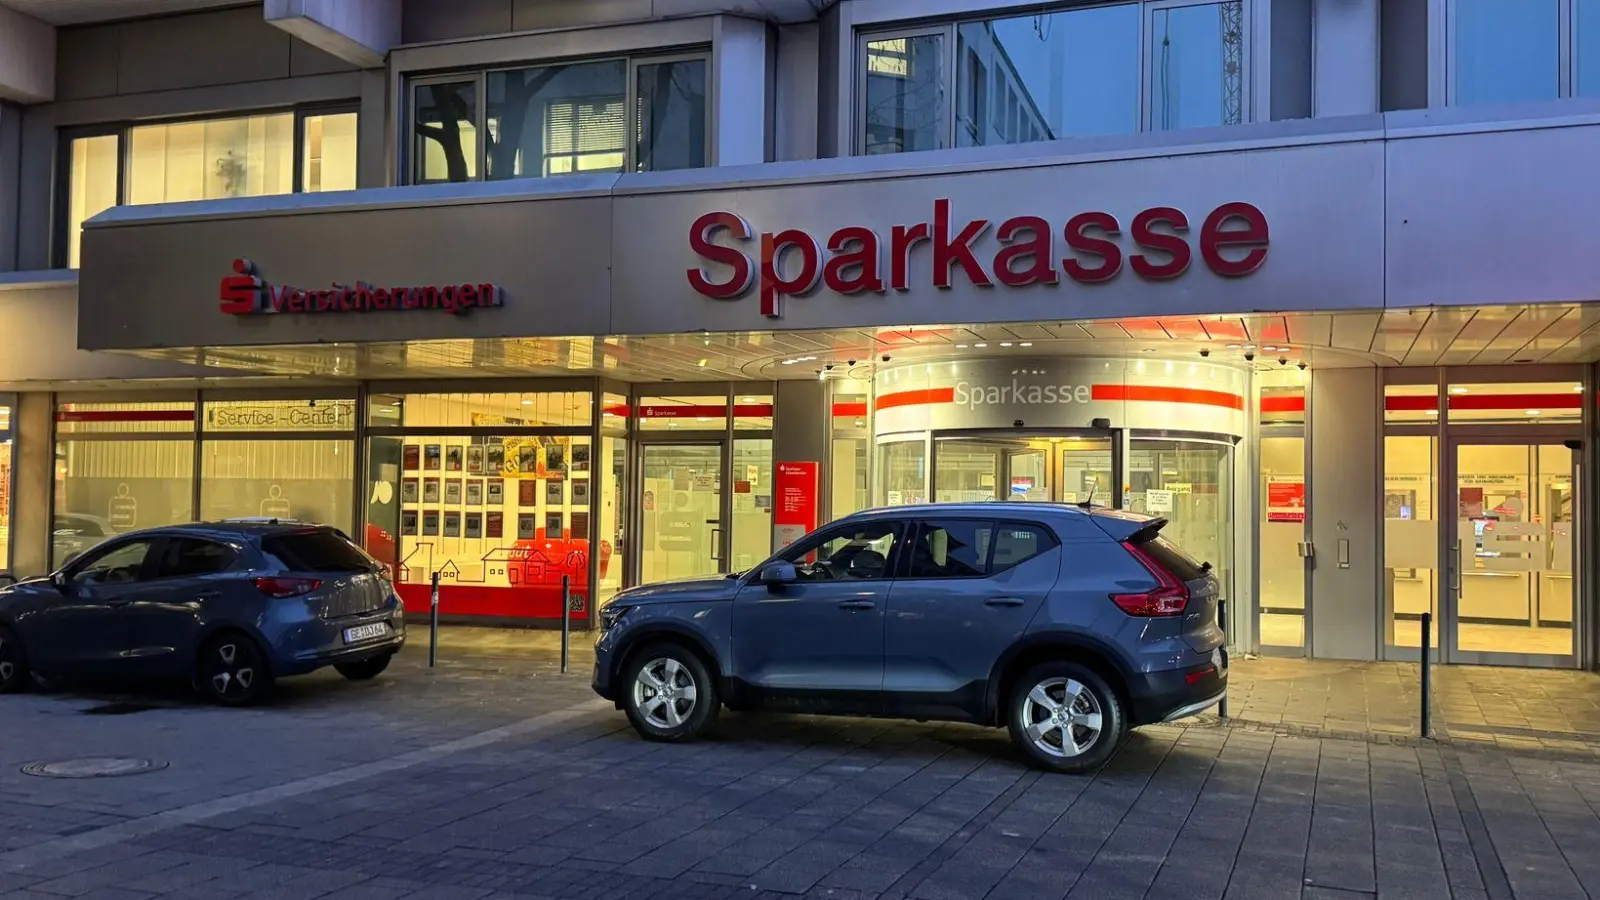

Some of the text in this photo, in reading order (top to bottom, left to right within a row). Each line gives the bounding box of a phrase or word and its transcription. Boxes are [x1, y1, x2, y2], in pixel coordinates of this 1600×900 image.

[687, 198, 1270, 317] Sparkasse
[270, 280, 501, 315] Versicherungen
[955, 378, 1090, 411] Sparkasse
[218, 410, 275, 425] Service
[290, 408, 345, 425] Center
